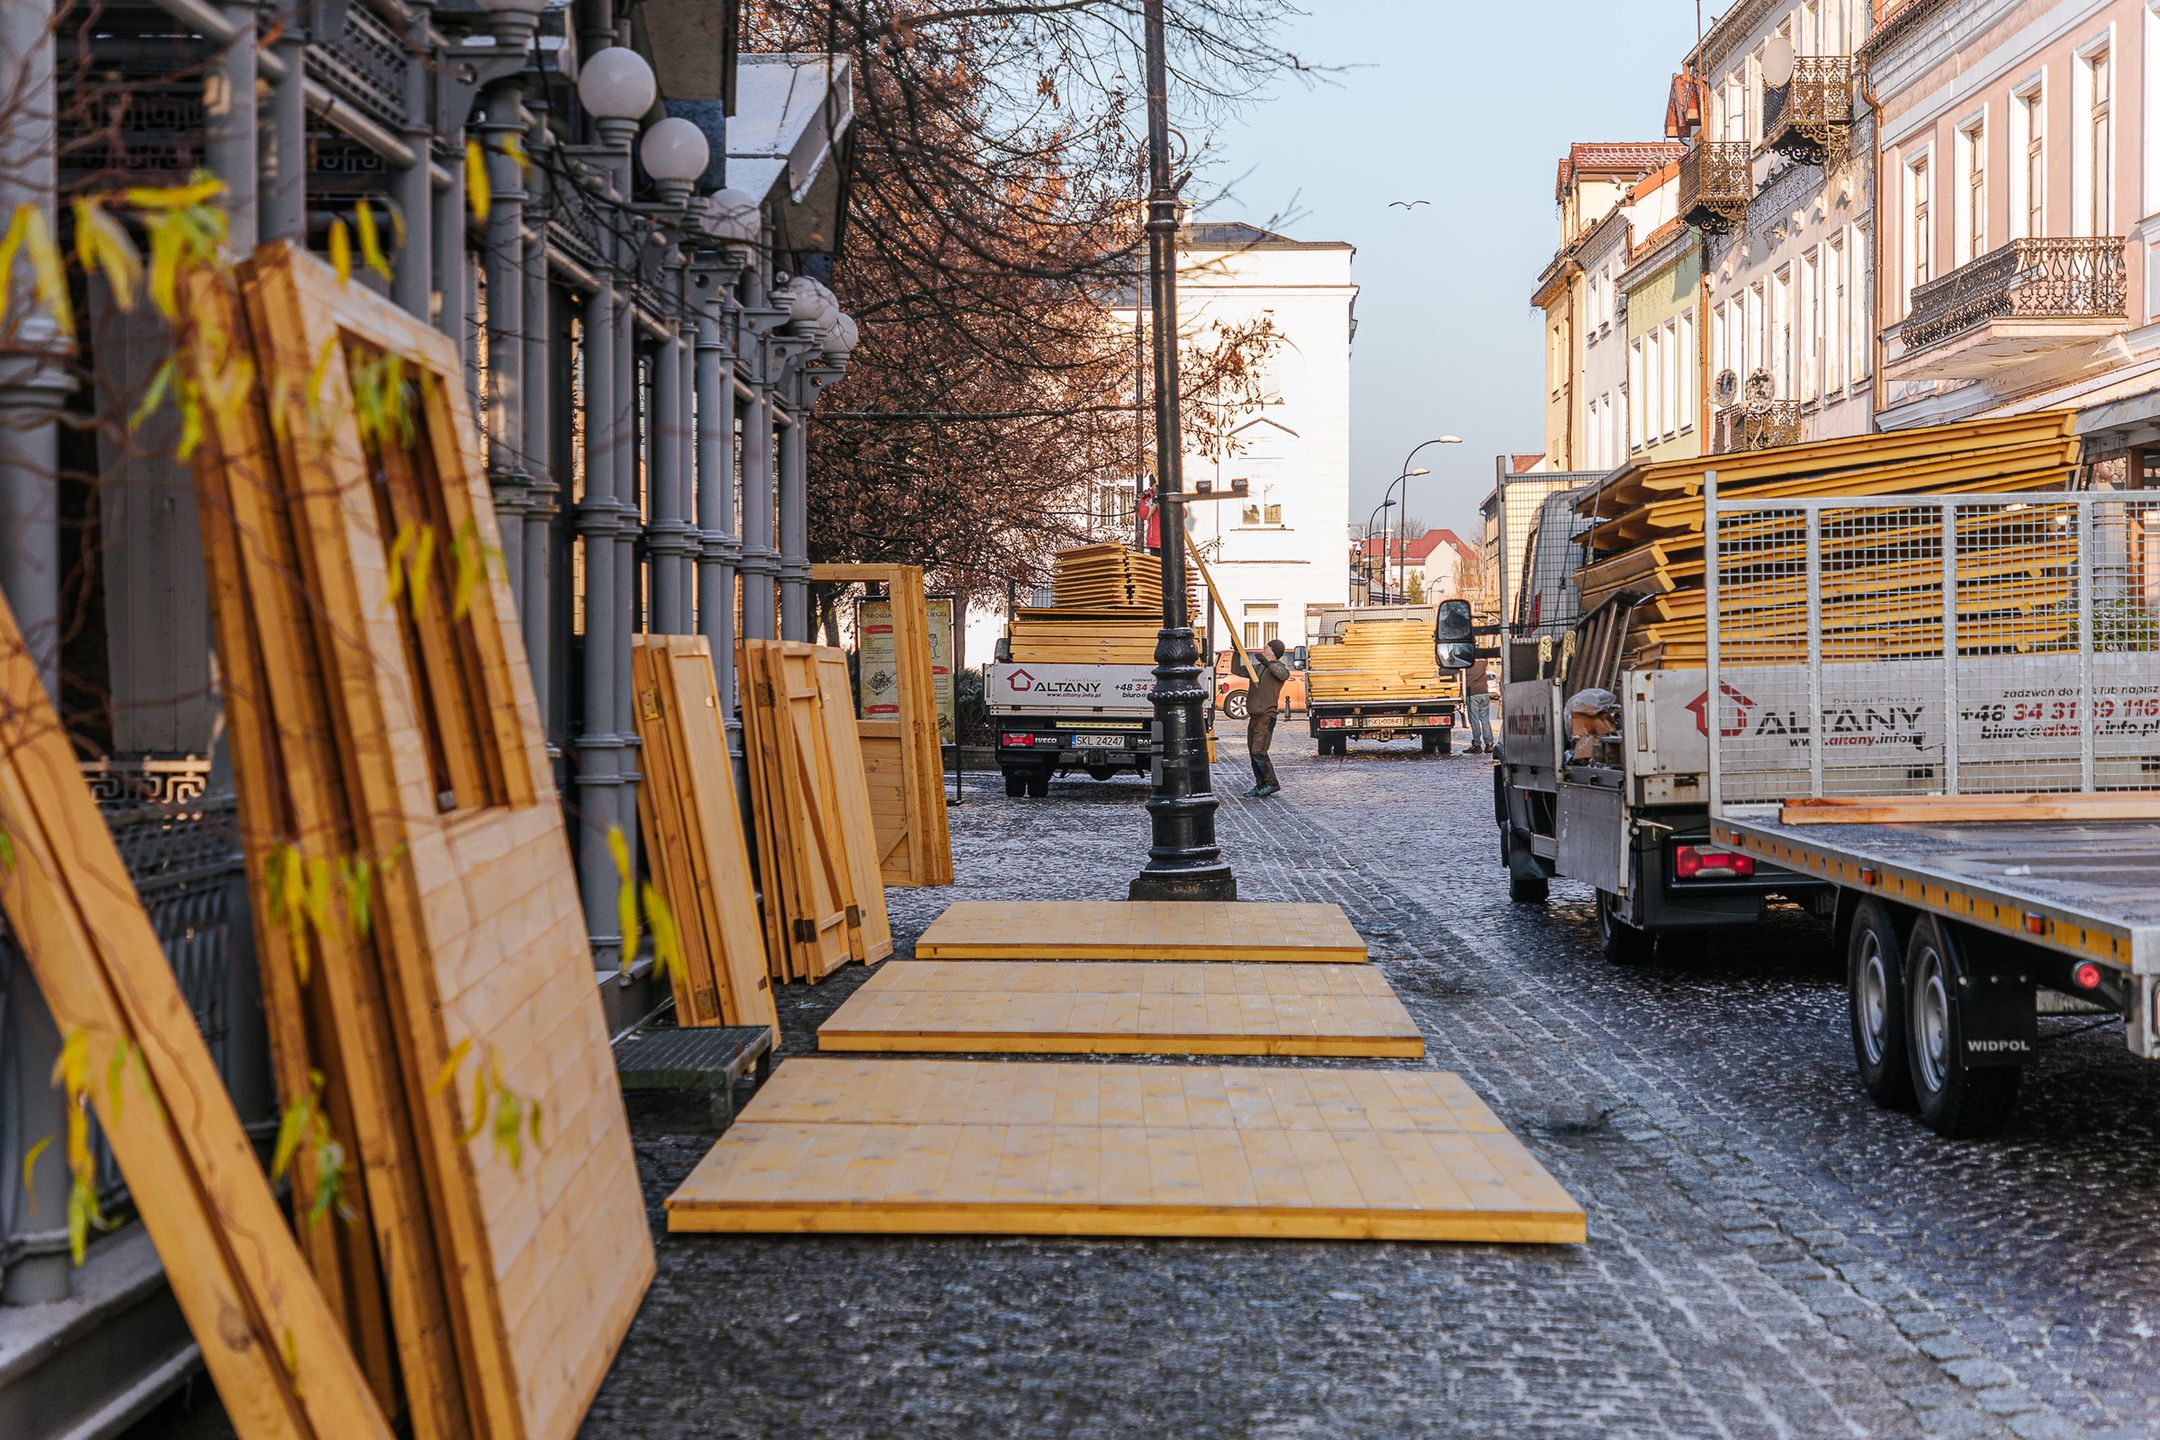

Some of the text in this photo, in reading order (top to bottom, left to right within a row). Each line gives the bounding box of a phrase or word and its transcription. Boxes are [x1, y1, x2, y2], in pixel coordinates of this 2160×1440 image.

[1034, 682, 1101, 692] ALTANY
[2058, 687, 2073, 696] do
[2100, 686, 2118, 695] lub
[2121, 686, 2159, 696] napisz
[1960, 703, 2006, 721] +48
[2013, 702, 2043, 721] 34
[2050, 701, 2078, 720] 31
[2123, 698, 2159, 717] 116
[1076, 736, 1123, 746] SKL 24247
[1968, 1040, 2030, 1052] WIDPOL
